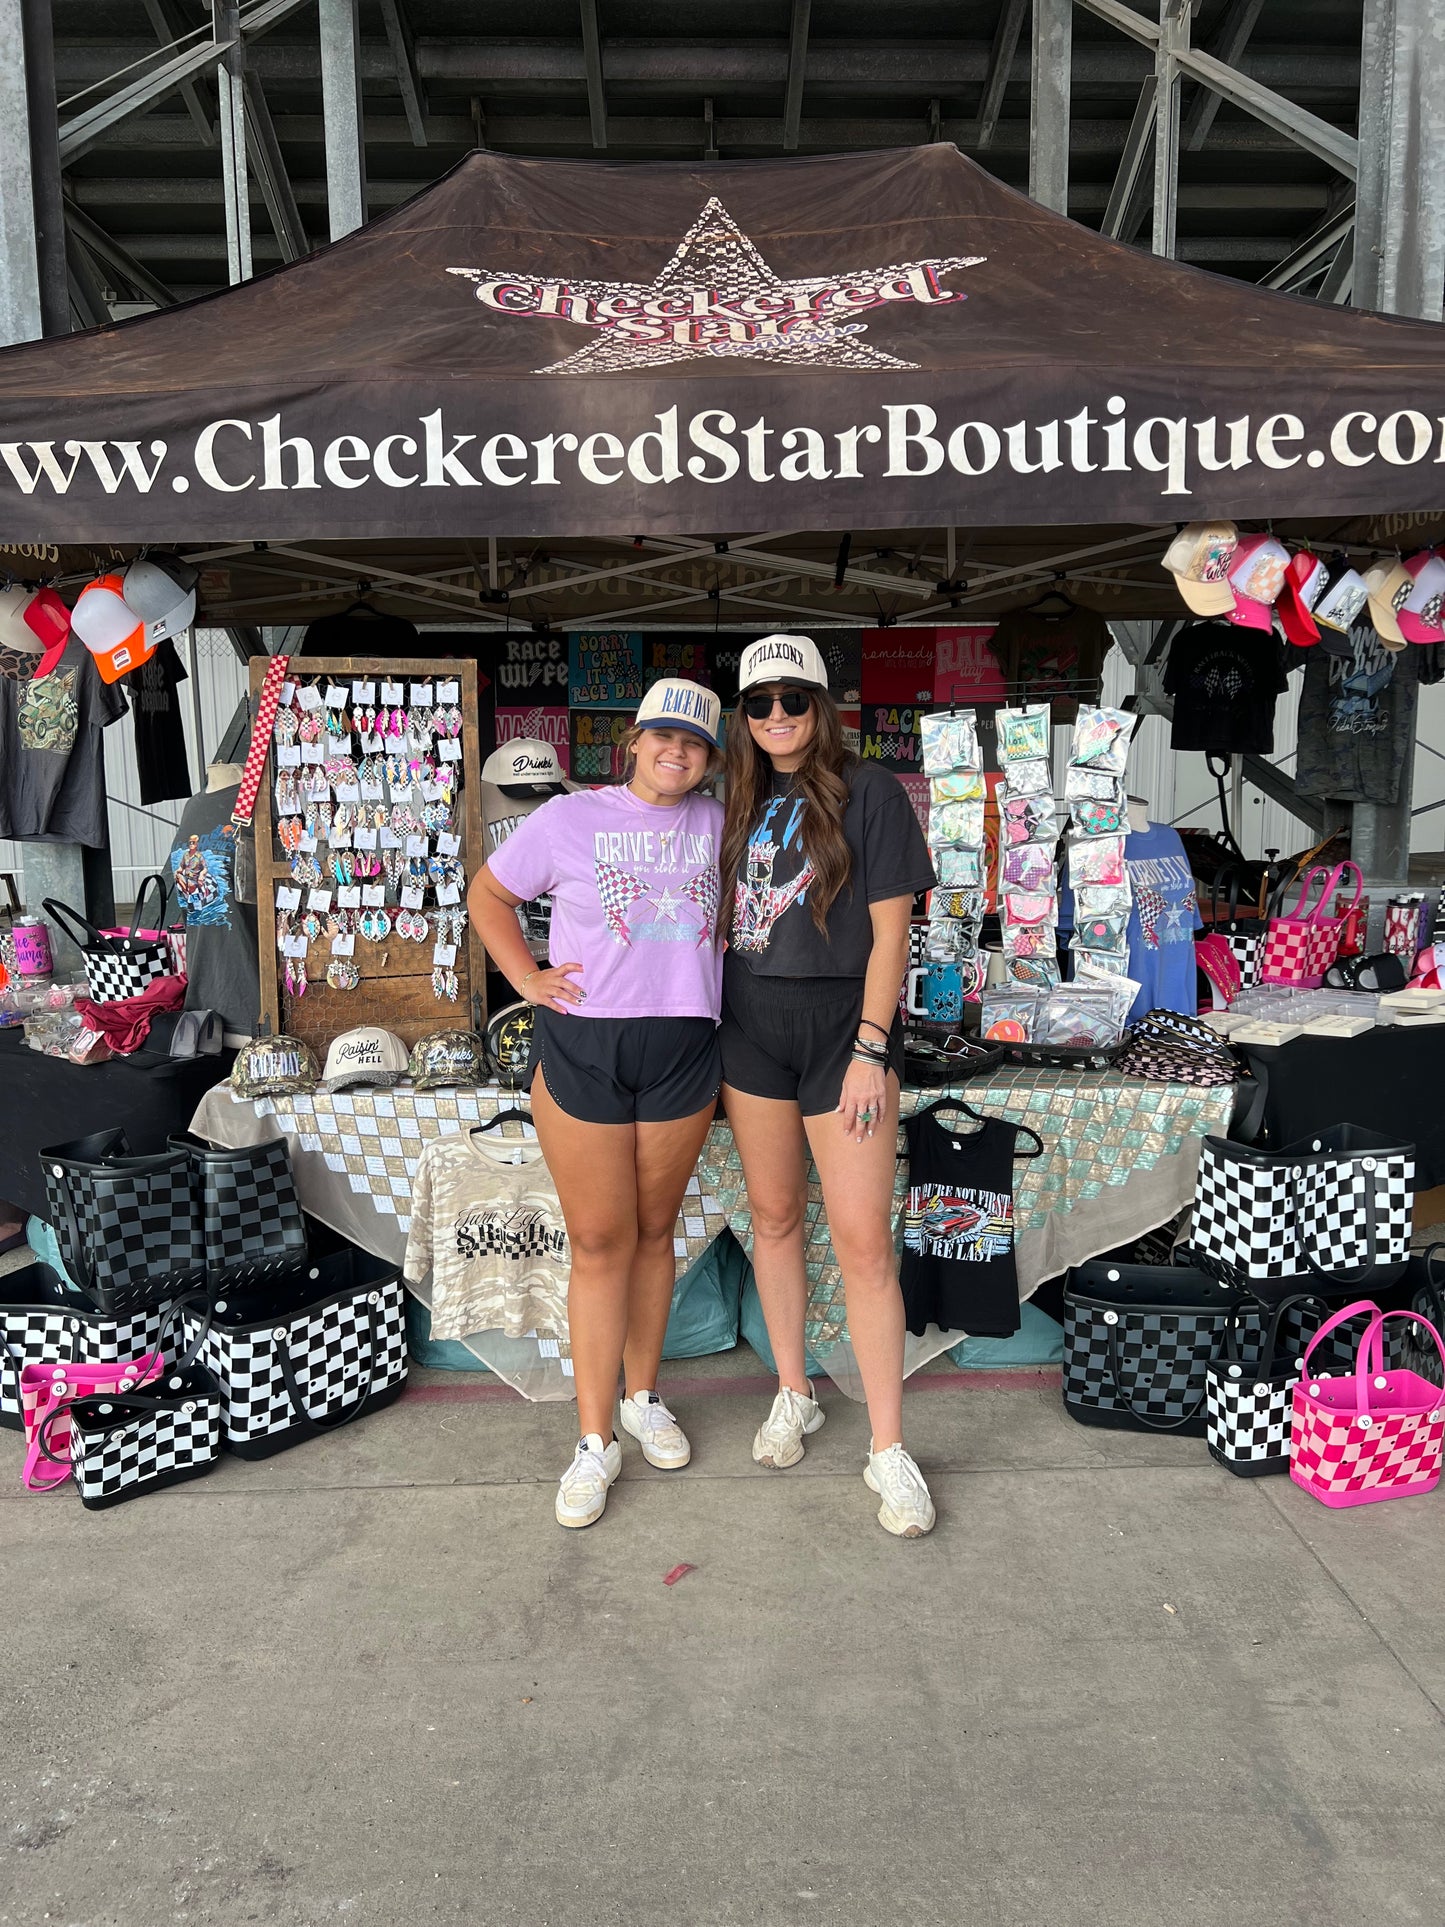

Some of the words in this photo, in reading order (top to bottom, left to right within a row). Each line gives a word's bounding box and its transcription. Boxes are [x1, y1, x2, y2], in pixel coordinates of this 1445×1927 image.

[613, 311, 814, 346] Star
[706, 323, 869, 357] Boutique
[0, 394, 1445, 496] ww.CheckeredStarBoutique.co
[506, 641, 562, 661] RACE
[579, 634, 630, 653] SORRY
[591, 649, 633, 667] CAN'T
[586, 667, 616, 684] IT'S
[570, 686, 609, 703] RACE
[615, 680, 644, 699] DAY
[662, 687, 692, 713] RACE
[693, 694, 711, 726] DAY
[874, 708, 926, 734] RACE
[512, 755, 553, 774] Drinks
[594, 832, 655, 862] DRIVE
[633, 864, 650, 877] you
[654, 861, 679, 876] stole
[336, 1040, 384, 1065] Raisin'
[358, 1055, 383, 1064] HELL
[426, 1046, 474, 1064] Drinks
[250, 1052, 277, 1078] RACE
[280, 1052, 300, 1077] DAY
[955, 1188, 976, 1201] NOT
[978, 1190, 1011, 1224] FIRST
[455, 1208, 498, 1226] Turn
[501, 1206, 548, 1230] Left
[478, 1223, 527, 1243] Raise
